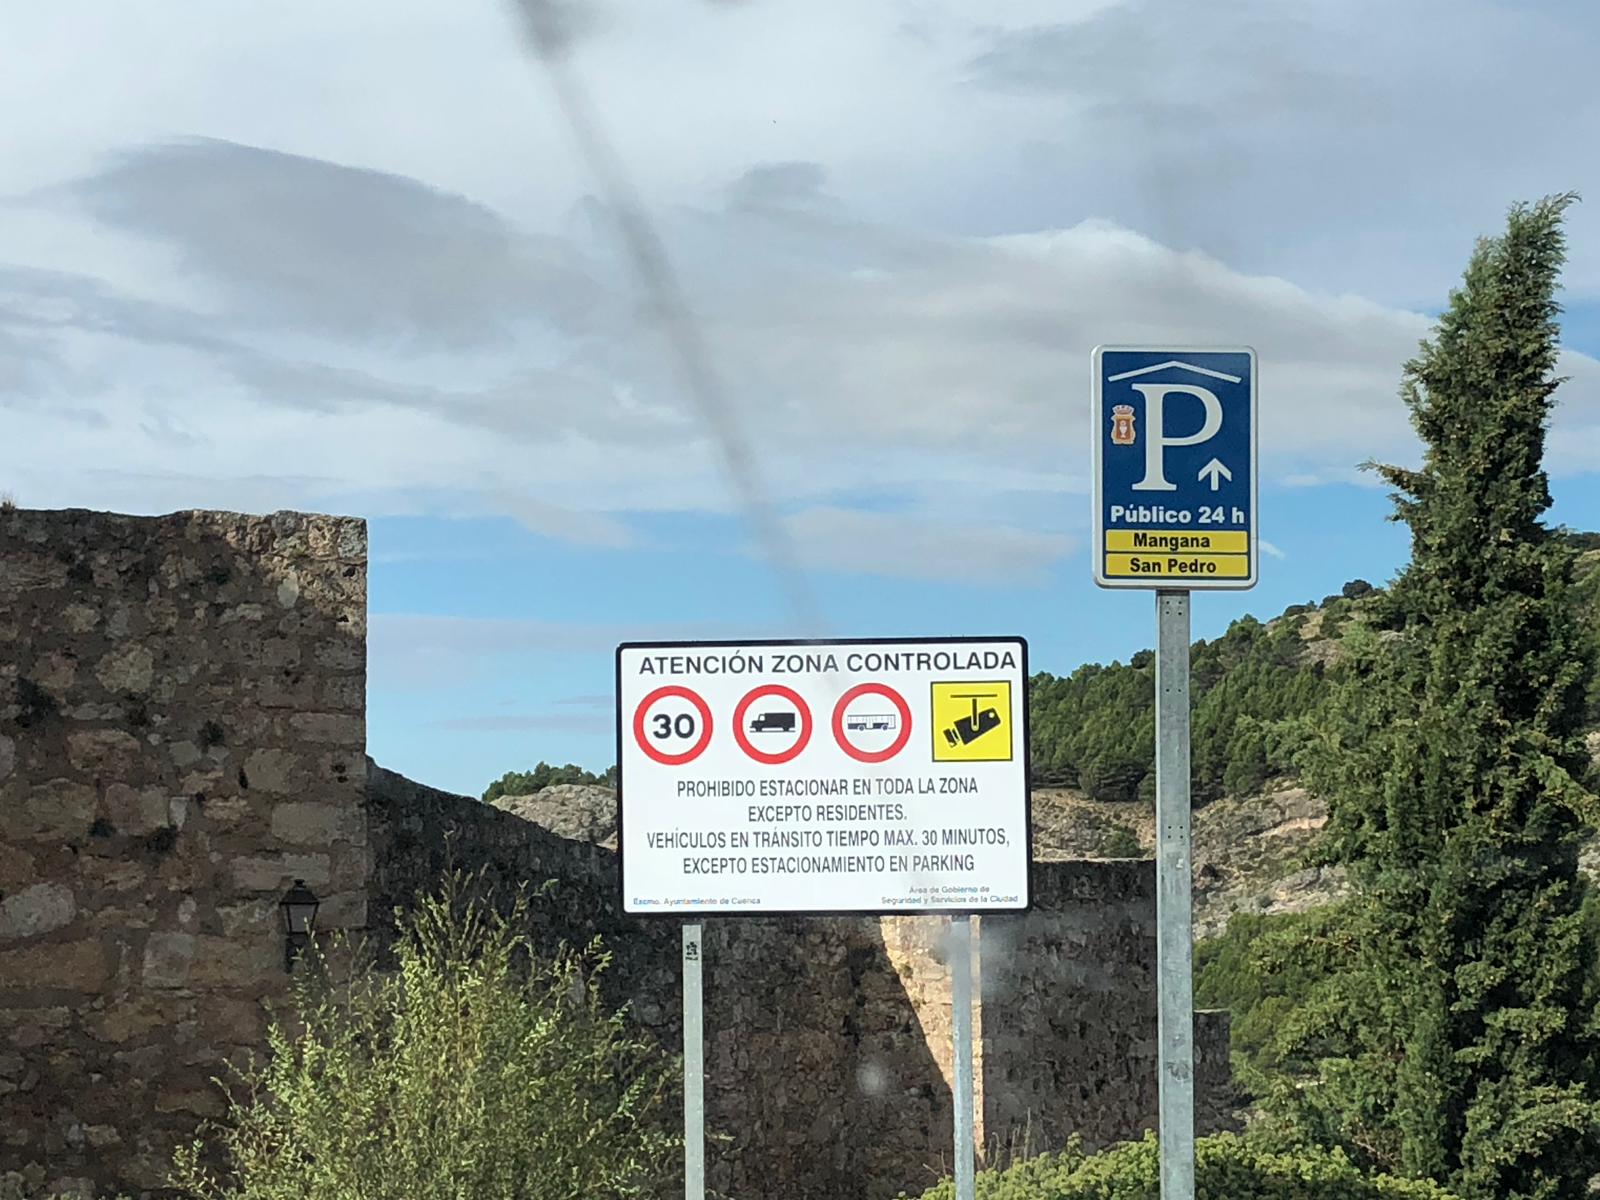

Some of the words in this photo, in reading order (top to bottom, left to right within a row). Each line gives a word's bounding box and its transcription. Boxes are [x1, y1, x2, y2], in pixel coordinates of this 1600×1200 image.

[1131, 383, 1223, 491] P
[1110, 504, 1192, 524] Público
[1198, 506, 1225, 524] 24
[1232, 507, 1245, 524] h
[1133, 533, 1211, 550] Mangana
[1129, 557, 1162, 573] San
[1168, 558, 1217, 573] Pedro
[639, 650, 763, 675] ATENCIÓN
[771, 653, 839, 674] ZONA
[846, 651, 1017, 673] CONTROLADA
[652, 713, 695, 739] 30
[677, 780, 756, 797] PROHIBIDO
[760, 779, 849, 796] ESTACIONAR
[853, 779, 872, 795] EN
[876, 778, 914, 795] TODA
[918, 778, 936, 794] LA
[939, 777, 979, 794] ZONA
[748, 805, 812, 822] EXCEPTO
[816, 804, 908, 821] RESIDENTES.
[647, 827, 726, 848] VEHÍCULOS
[730, 832, 749, 848] EN
[753, 826, 823, 848] TRÁNSITO
[826, 830, 880, 847] TIEMPO
[884, 829, 918, 846] MAX.
[922, 830, 938, 845] 30
[942, 828, 1010, 847] MINUTOS,
[683, 857, 747, 874] EXCEPTO
[751, 856, 885, 874] ESTACIONAMIENTO
[889, 855, 908, 872] EN
[912, 854, 975, 871] PARKING
[941, 886, 978, 894] Gobierno
[663, 897, 717, 907] Ayuntamiento
[719, 897, 729, 905] de
[731, 896, 761, 905] Cuenca
[881, 896, 922, 906] Seguridad
[980, 895, 988, 903] la
[989, 895, 1018, 903] Ciudad
